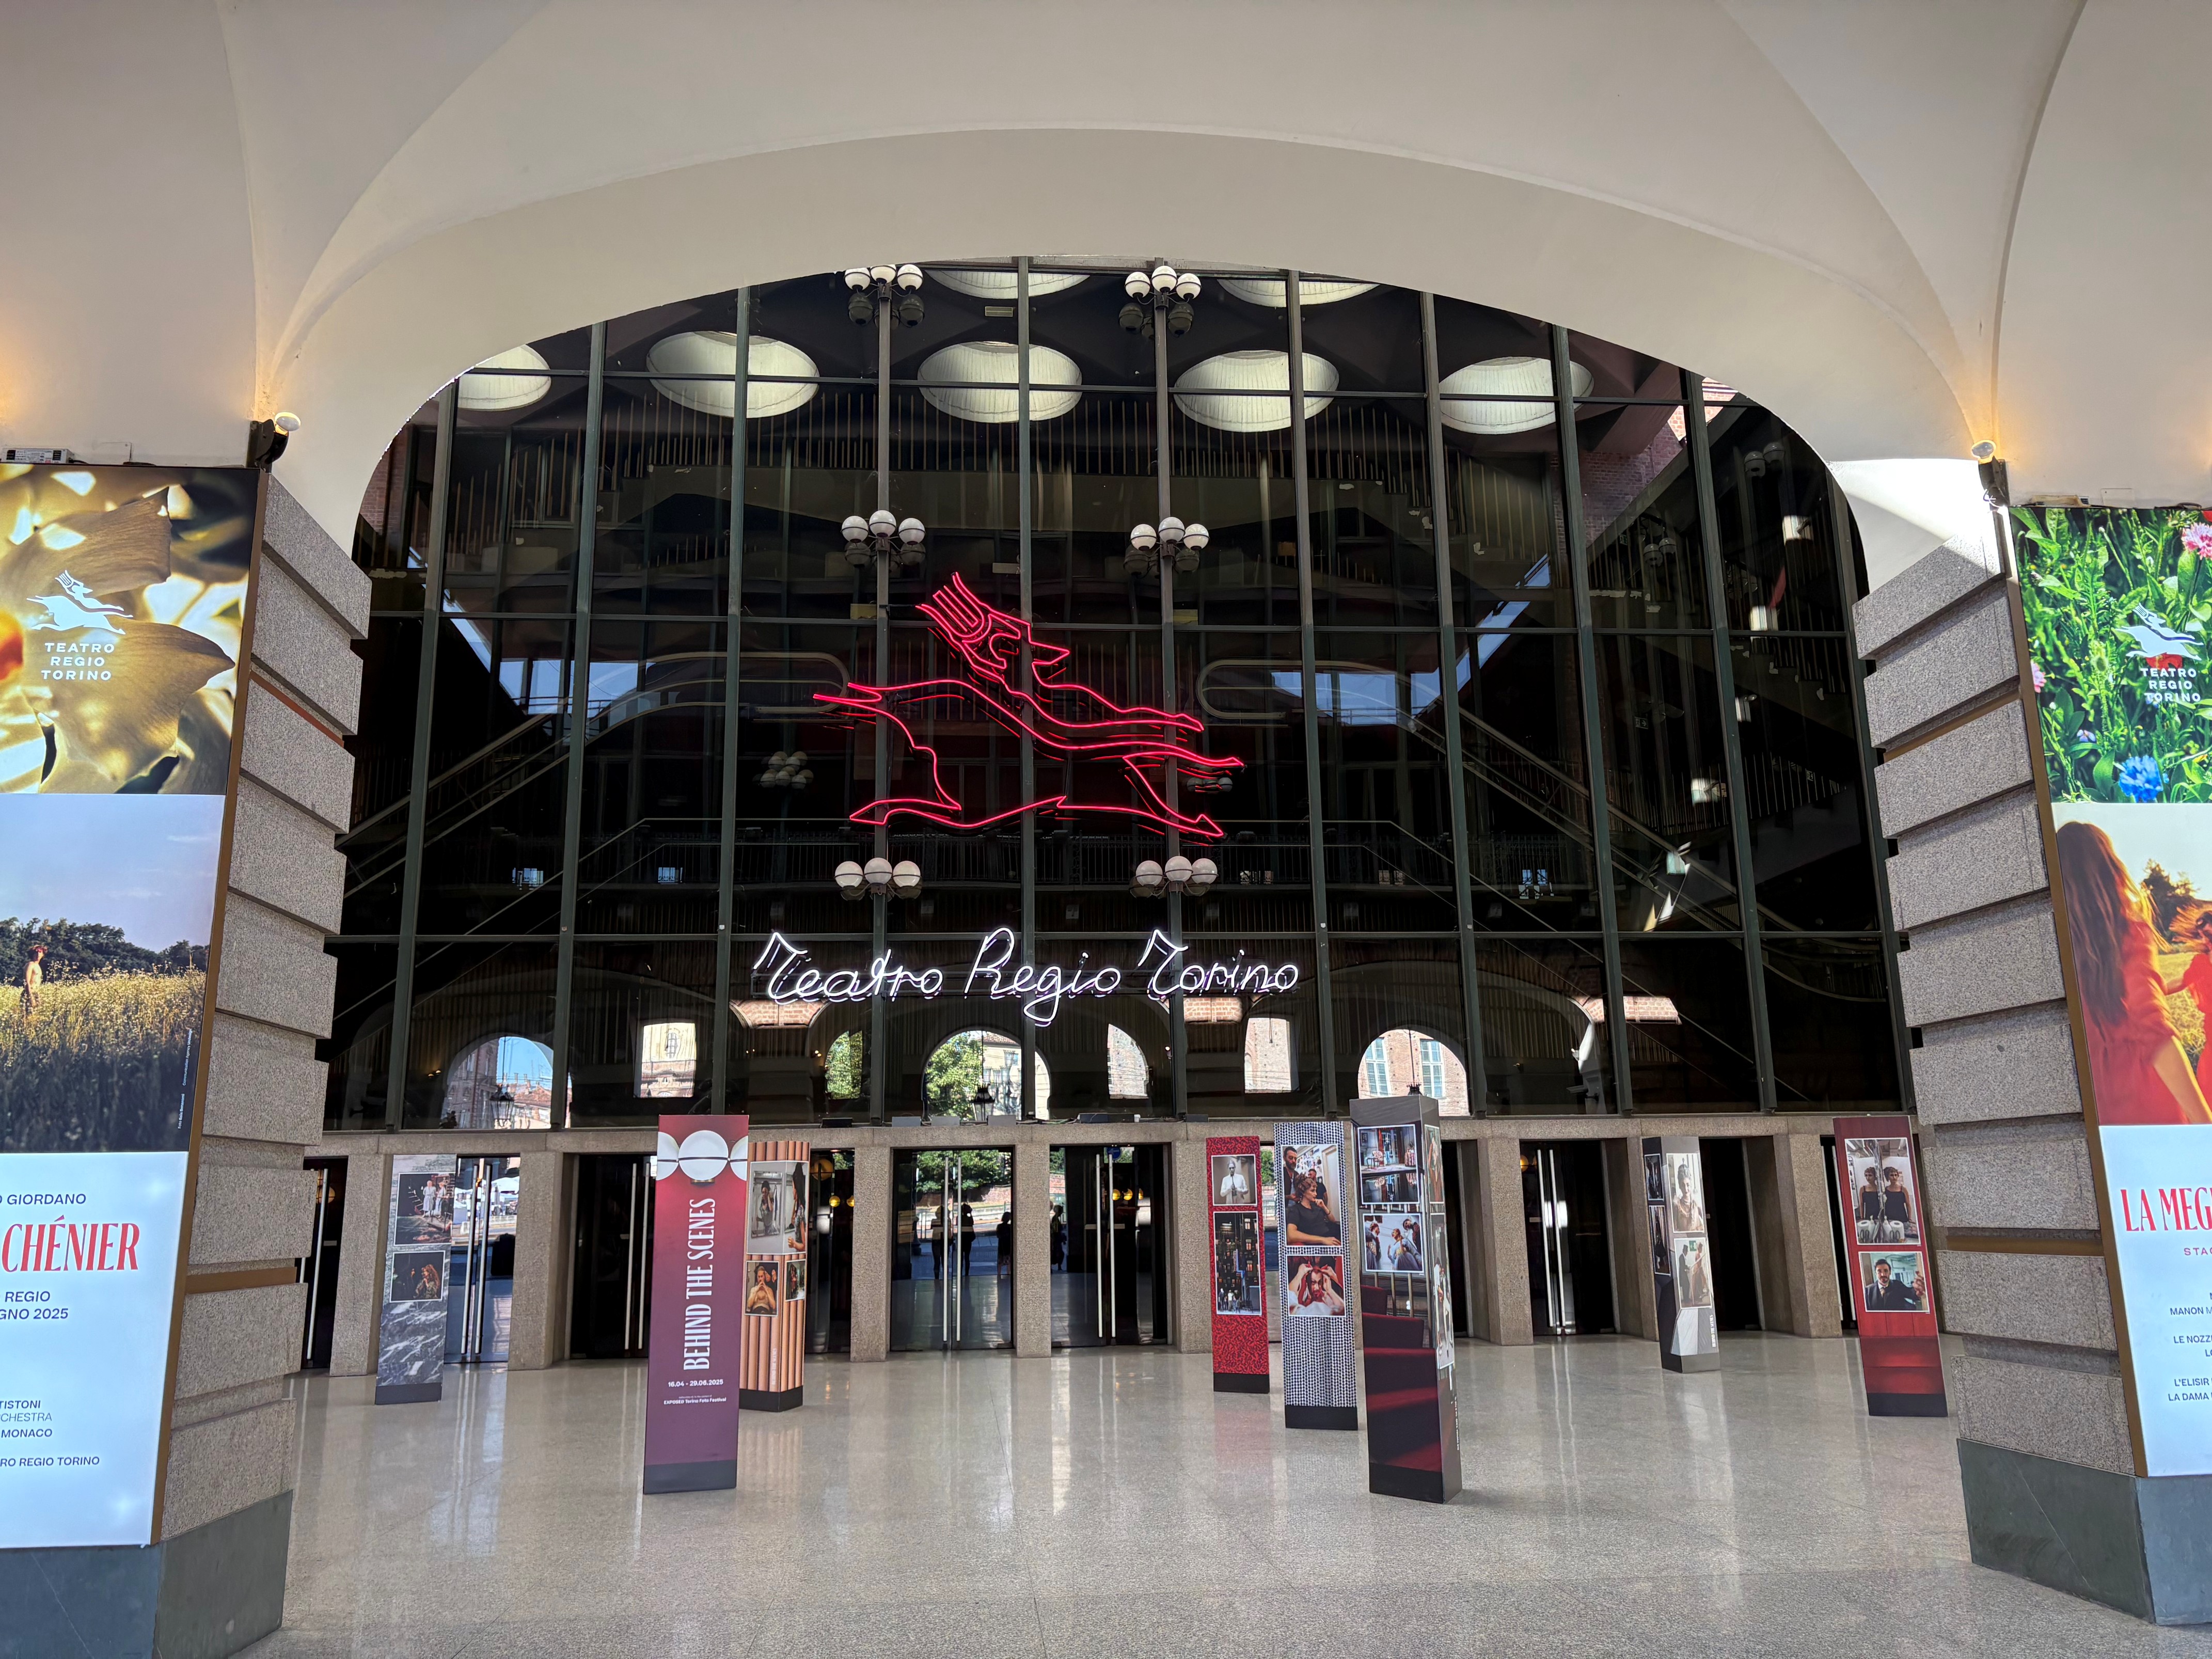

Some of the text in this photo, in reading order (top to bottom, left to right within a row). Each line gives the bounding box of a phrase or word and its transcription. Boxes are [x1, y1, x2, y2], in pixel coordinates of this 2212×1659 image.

[44, 642, 115, 653] TEATRO
[50, 656, 105, 667] REGIO
[41, 670, 112, 681] TORINO
[2140, 668, 2197, 677] TEATRO
[2149, 681, 2192, 690] REGIO
[2144, 692, 2201, 702] TORINO
[753, 927, 1299, 1022] Teatro Regio Torino
[7, 1193, 87, 1205] GIORDANO
[2120, 1187, 2212, 1231] LA MEG
[687, 1198, 716, 1260] SCENES
[2, 1214, 140, 1273] CHÉNIER
[686, 1265, 713, 1299] THE
[5, 1291, 51, 1302] REGIO
[33, 1308, 69, 1319] 2025
[2170, 1307, 2204, 1315] MANON
[684, 1304, 712, 1370] BEHIND
[2186, 1335, 2212, 1343] NOZZ
[2174, 1378, 2209, 1387] L'ELISIR
[2168, 1393, 2209, 1401] LA DAMA
[0, 1413, 52, 1422] CHESTRA
[1, 1429, 53, 1438] MONACO
[0, 1456, 100, 1467] RO REGIO TORINO
